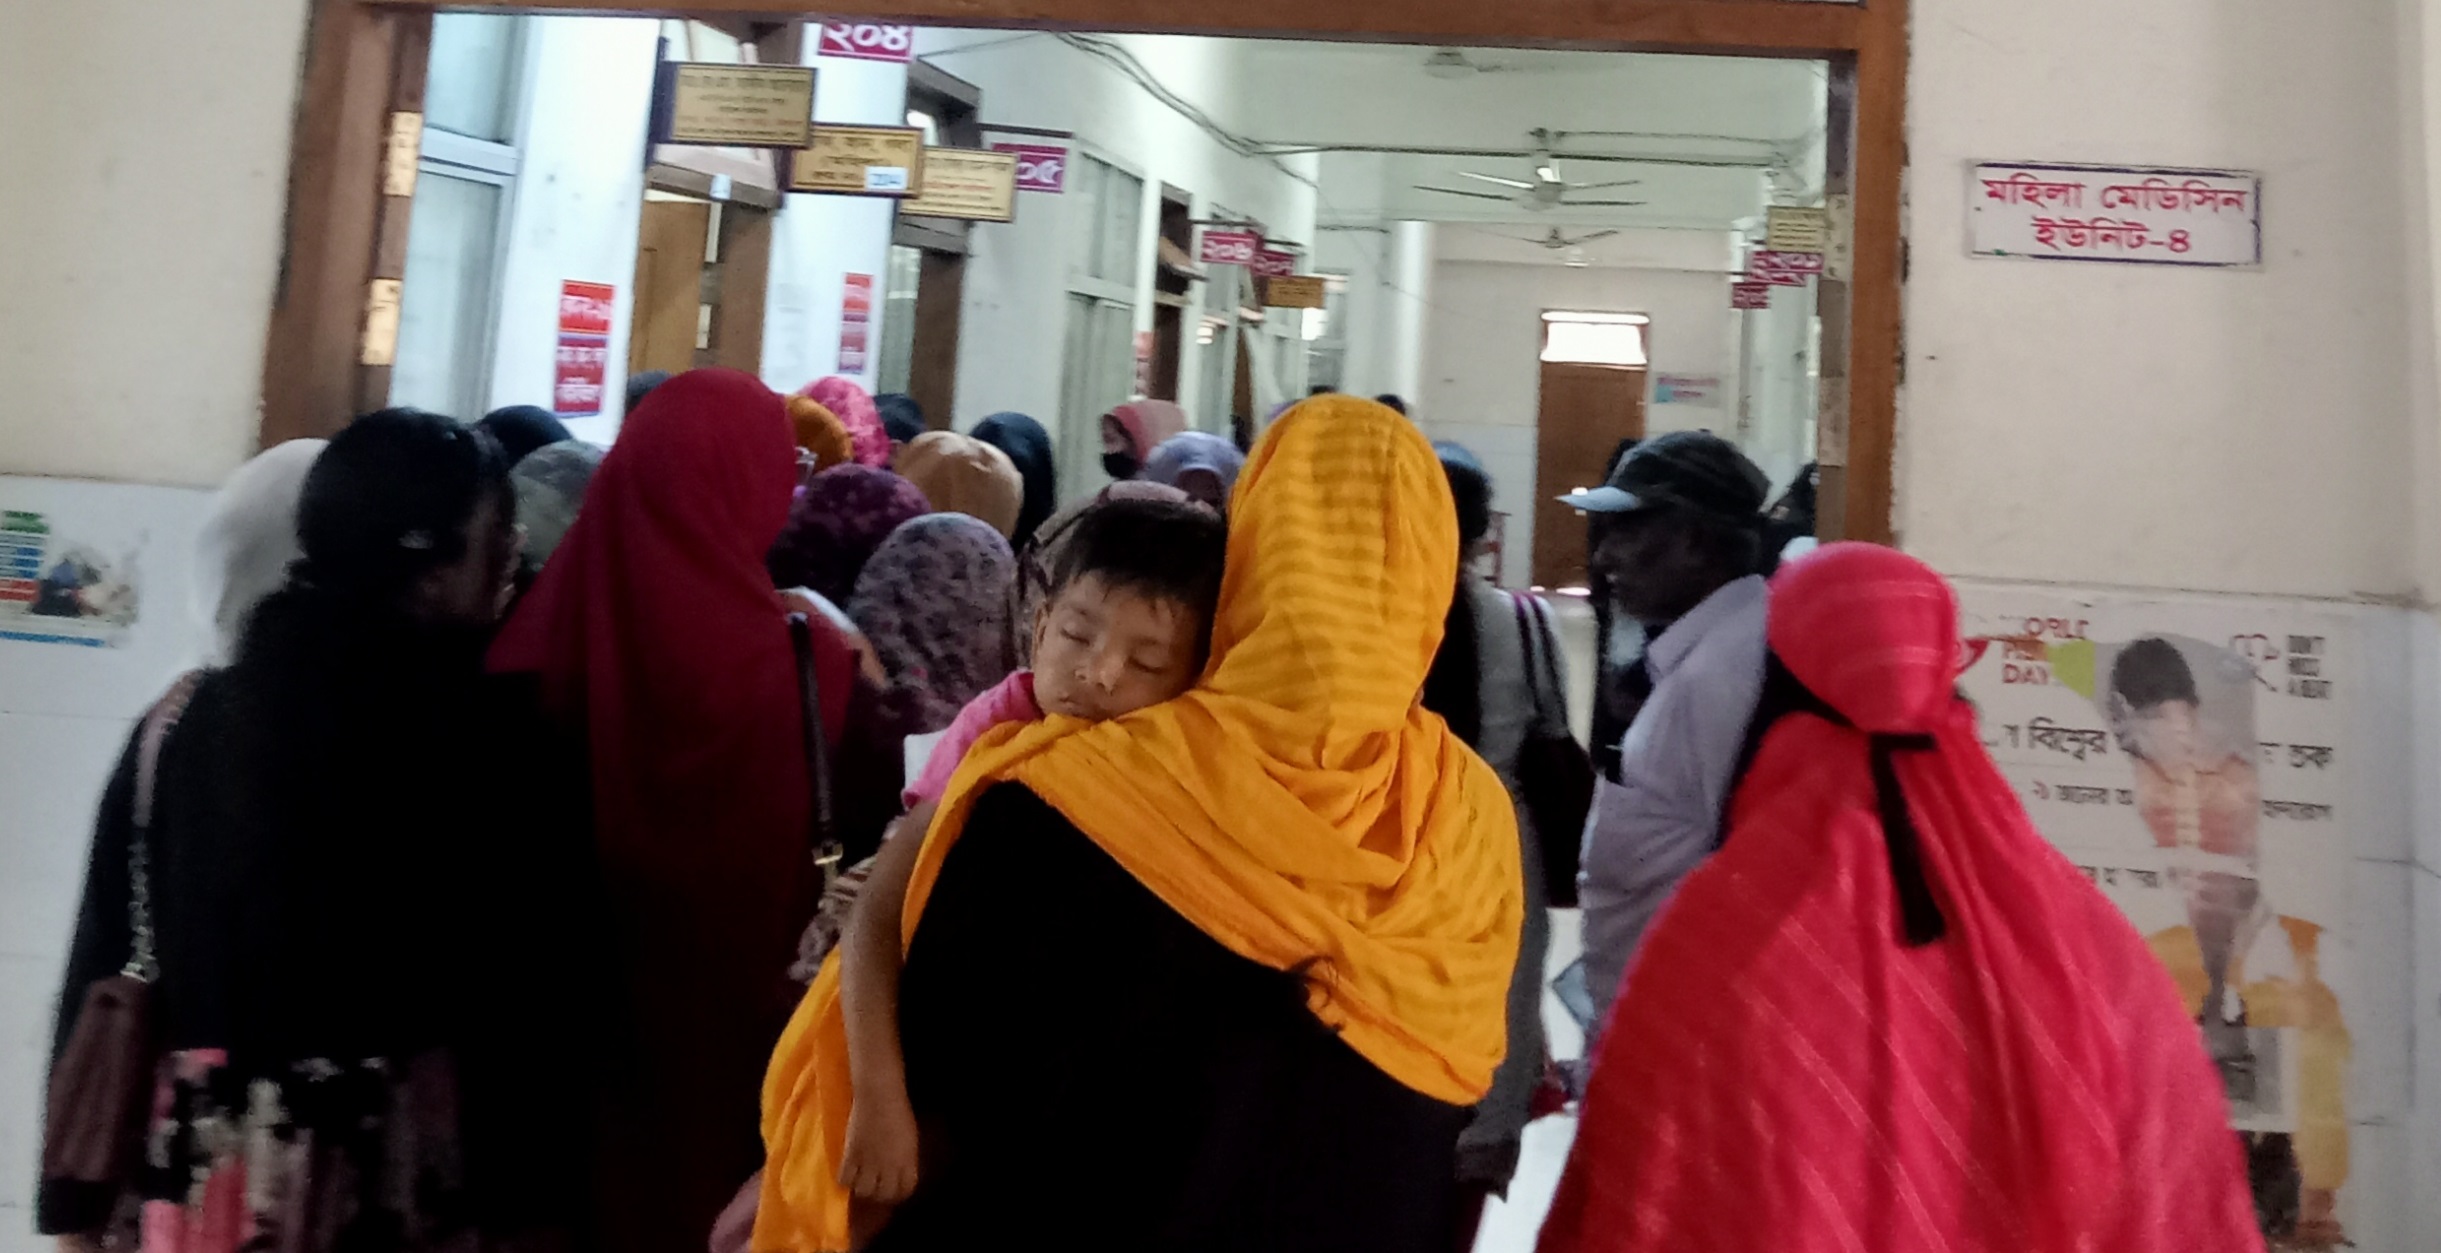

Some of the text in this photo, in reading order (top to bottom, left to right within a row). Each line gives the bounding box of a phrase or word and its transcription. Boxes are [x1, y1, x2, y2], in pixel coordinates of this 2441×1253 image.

[824, 22, 909, 53] ২০৪
[1016, 159, 1065, 184] ০৫
[1980, 172, 2249, 212] মহিলা মেডিসিন
